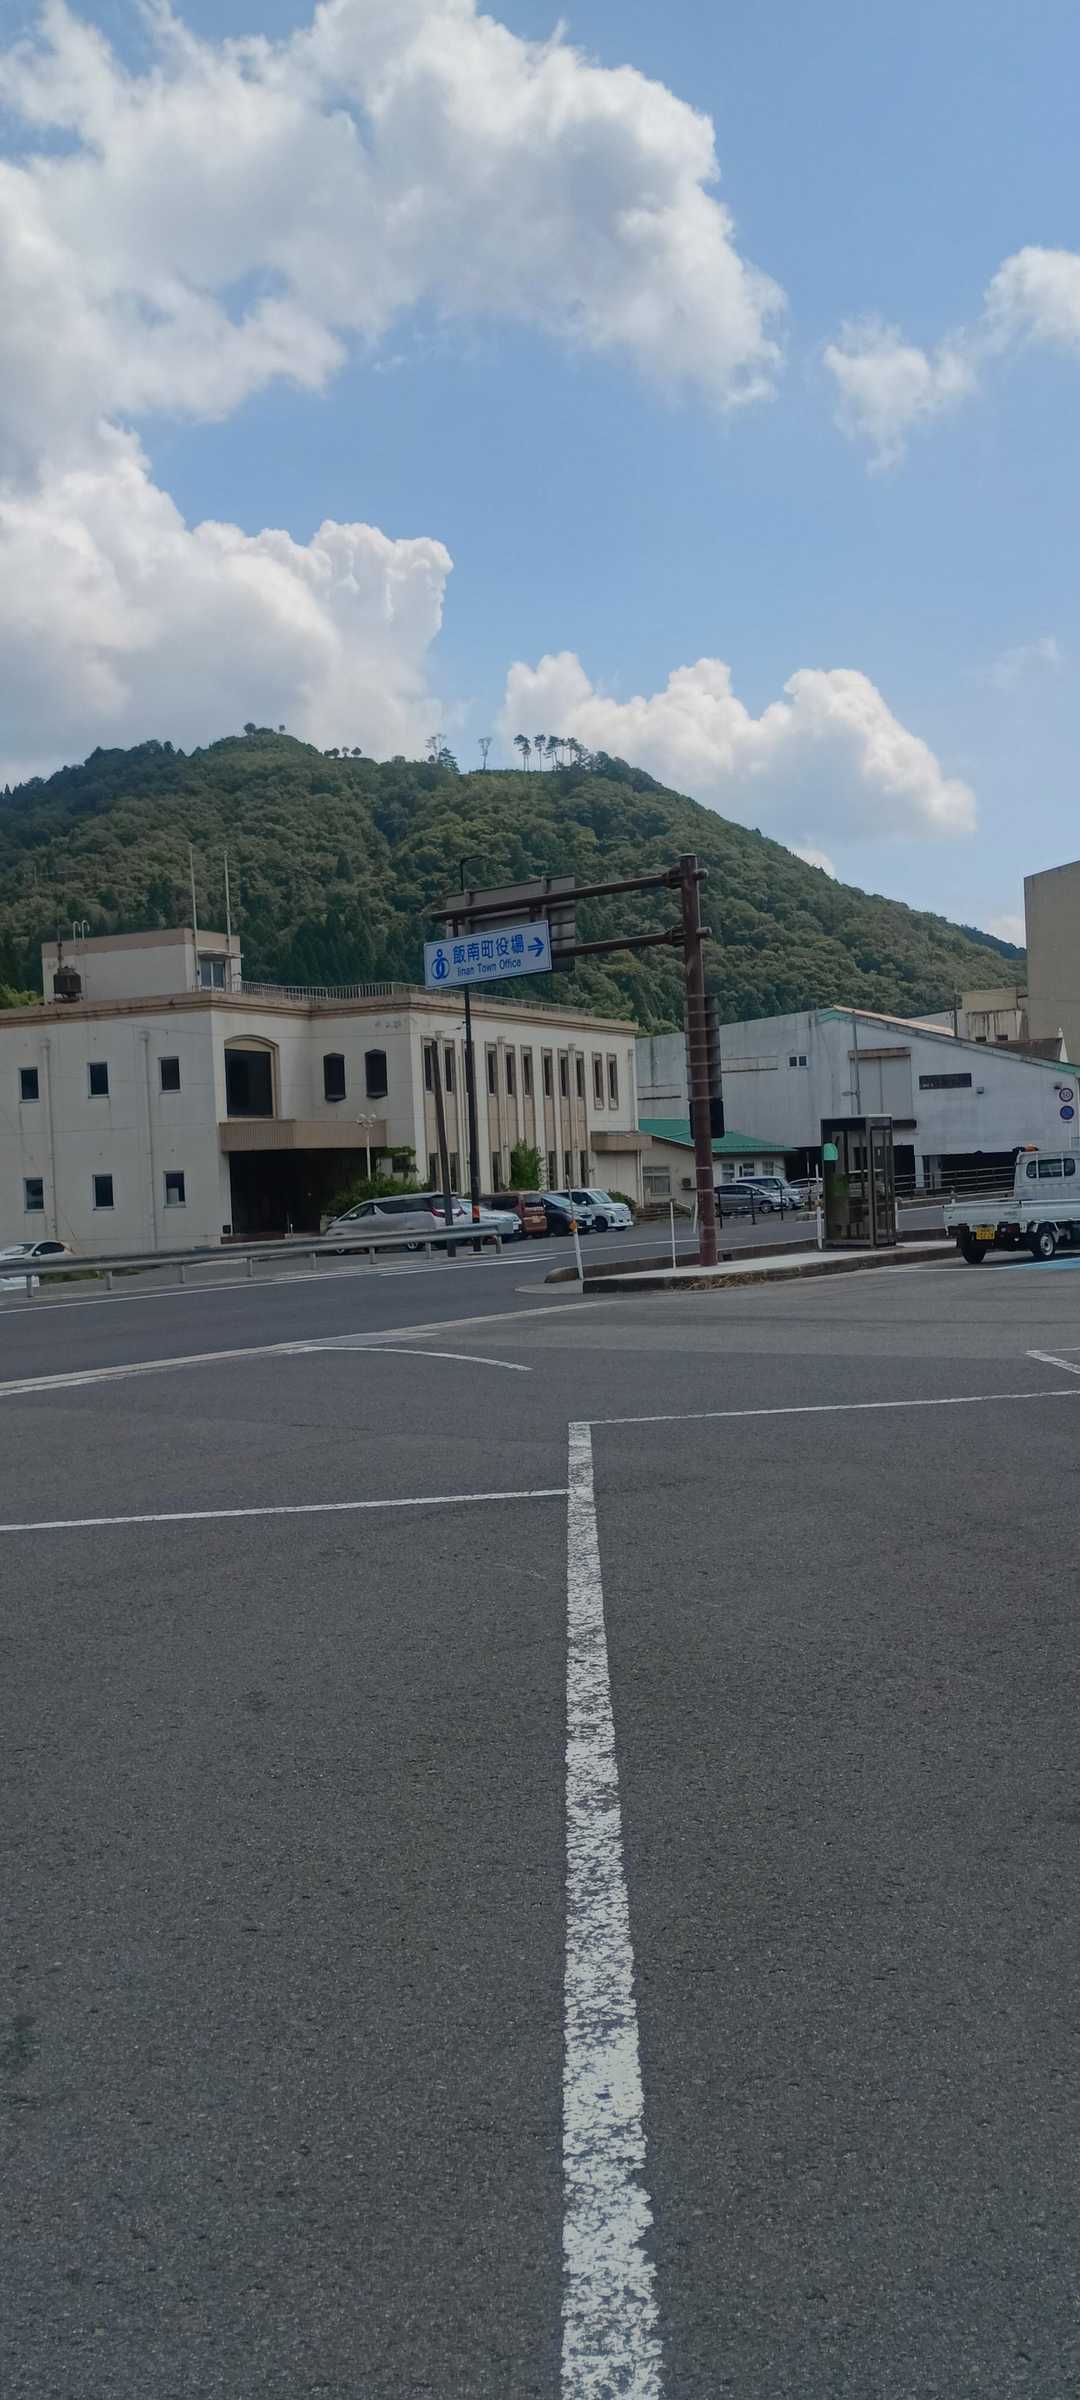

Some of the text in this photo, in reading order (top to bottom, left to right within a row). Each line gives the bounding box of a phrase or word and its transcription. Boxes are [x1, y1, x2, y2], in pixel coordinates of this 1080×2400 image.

[452, 934, 525, 965] 飯南町役場
[477, 962, 497, 974] Town
[499, 959, 521, 970] Office
